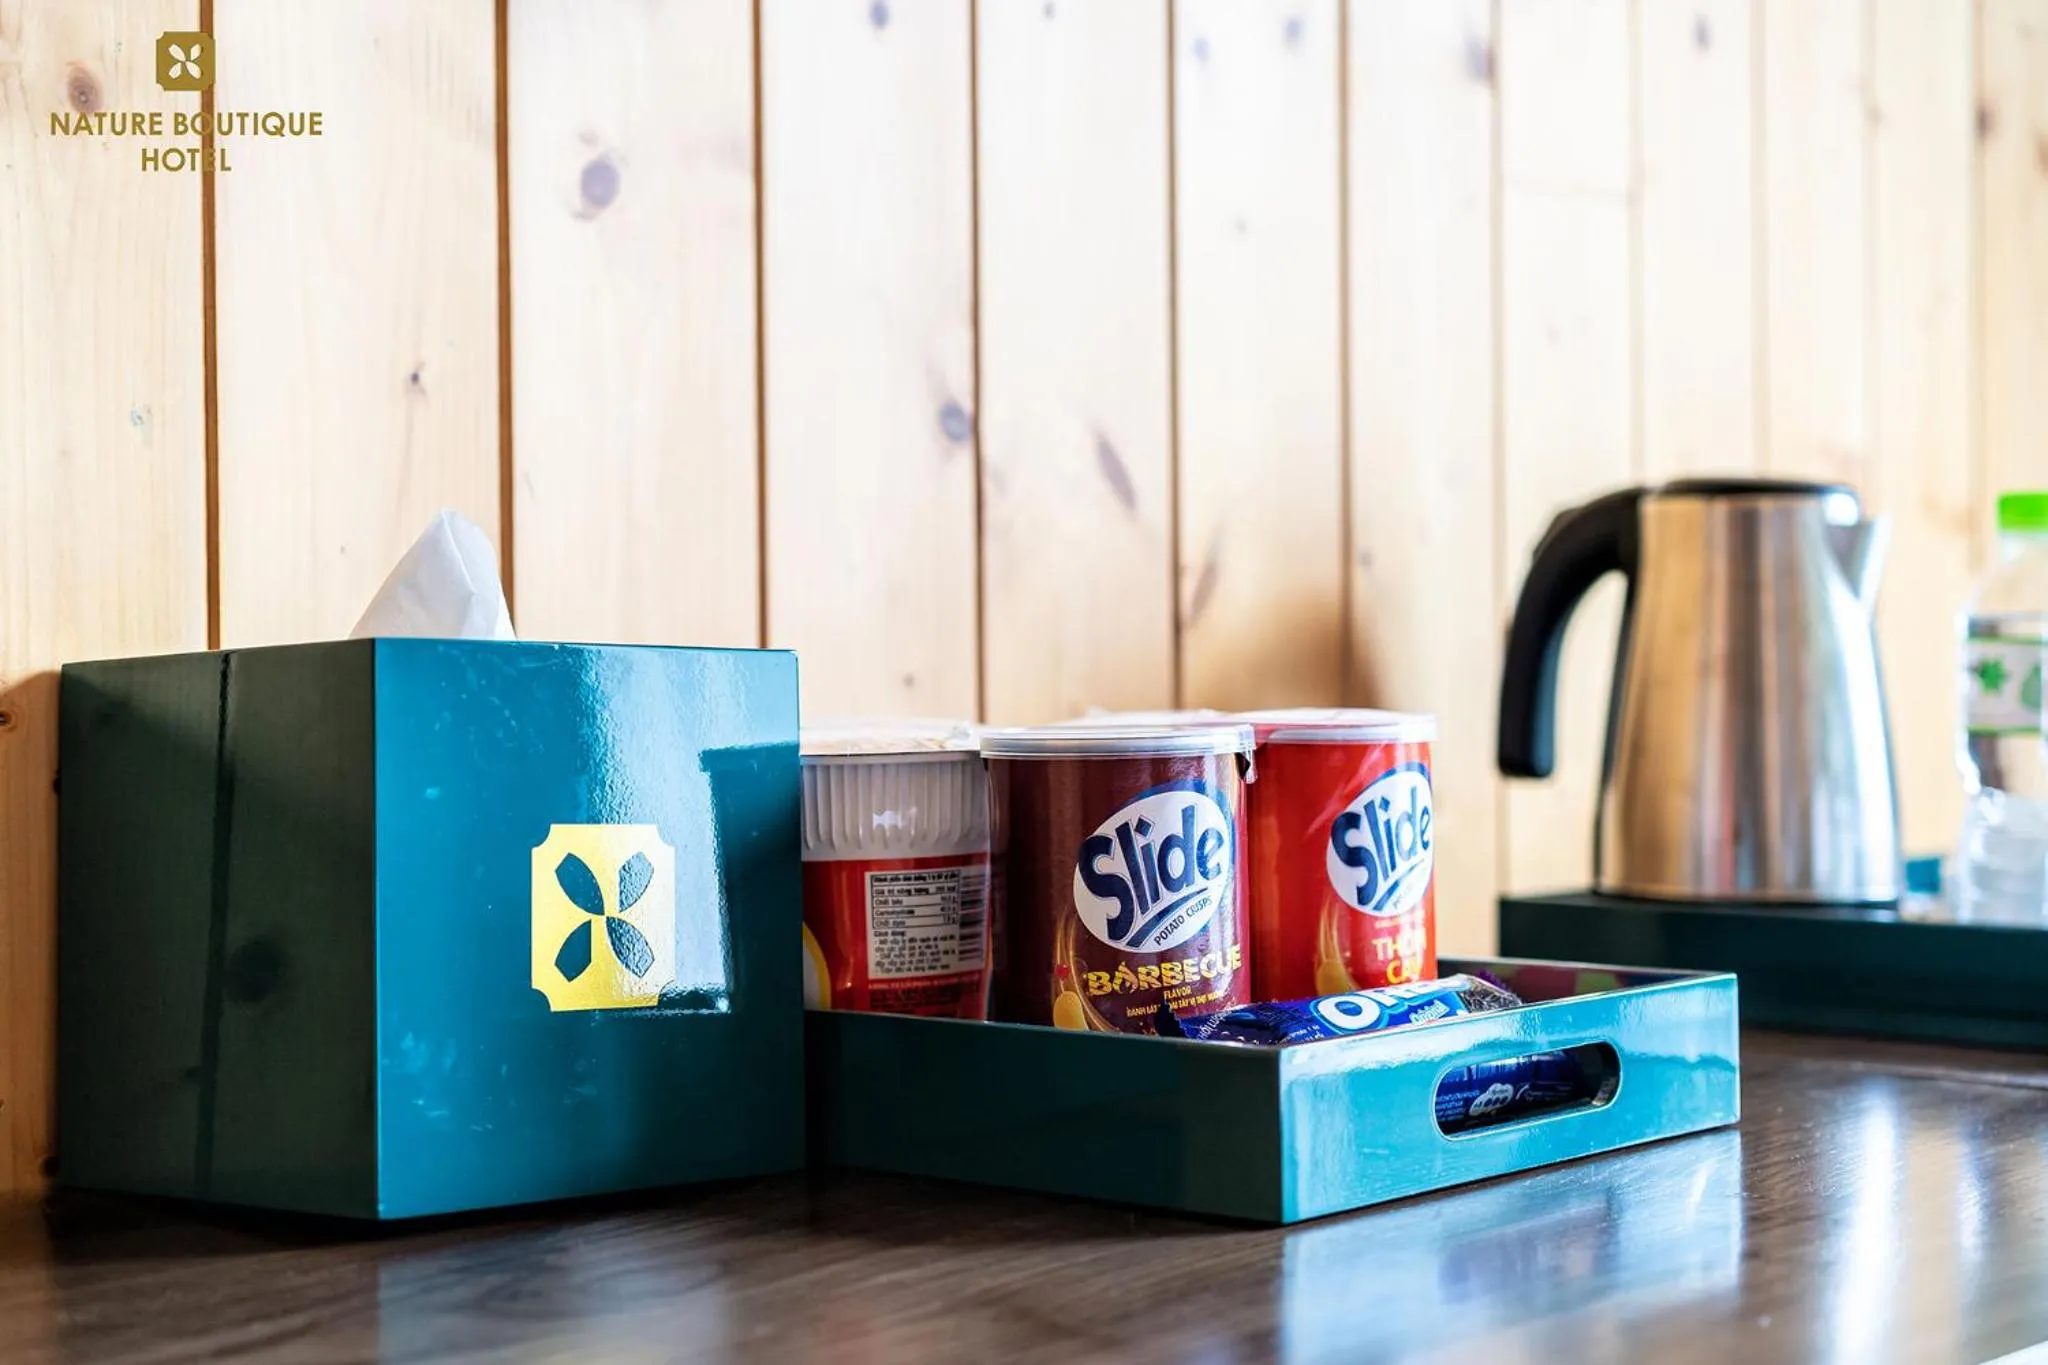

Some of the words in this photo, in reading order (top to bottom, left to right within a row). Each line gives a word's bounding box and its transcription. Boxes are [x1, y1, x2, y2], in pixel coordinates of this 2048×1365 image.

[1078, 804, 1225, 941] Slide
[1331, 786, 1431, 906] Slide
[1153, 914, 1186, 946] POTATO
[1186, 894, 1213, 918] CRISPS
[1087, 943, 1242, 996] BARBECUE
[1163, 985, 1192, 1000] FLAVOR
